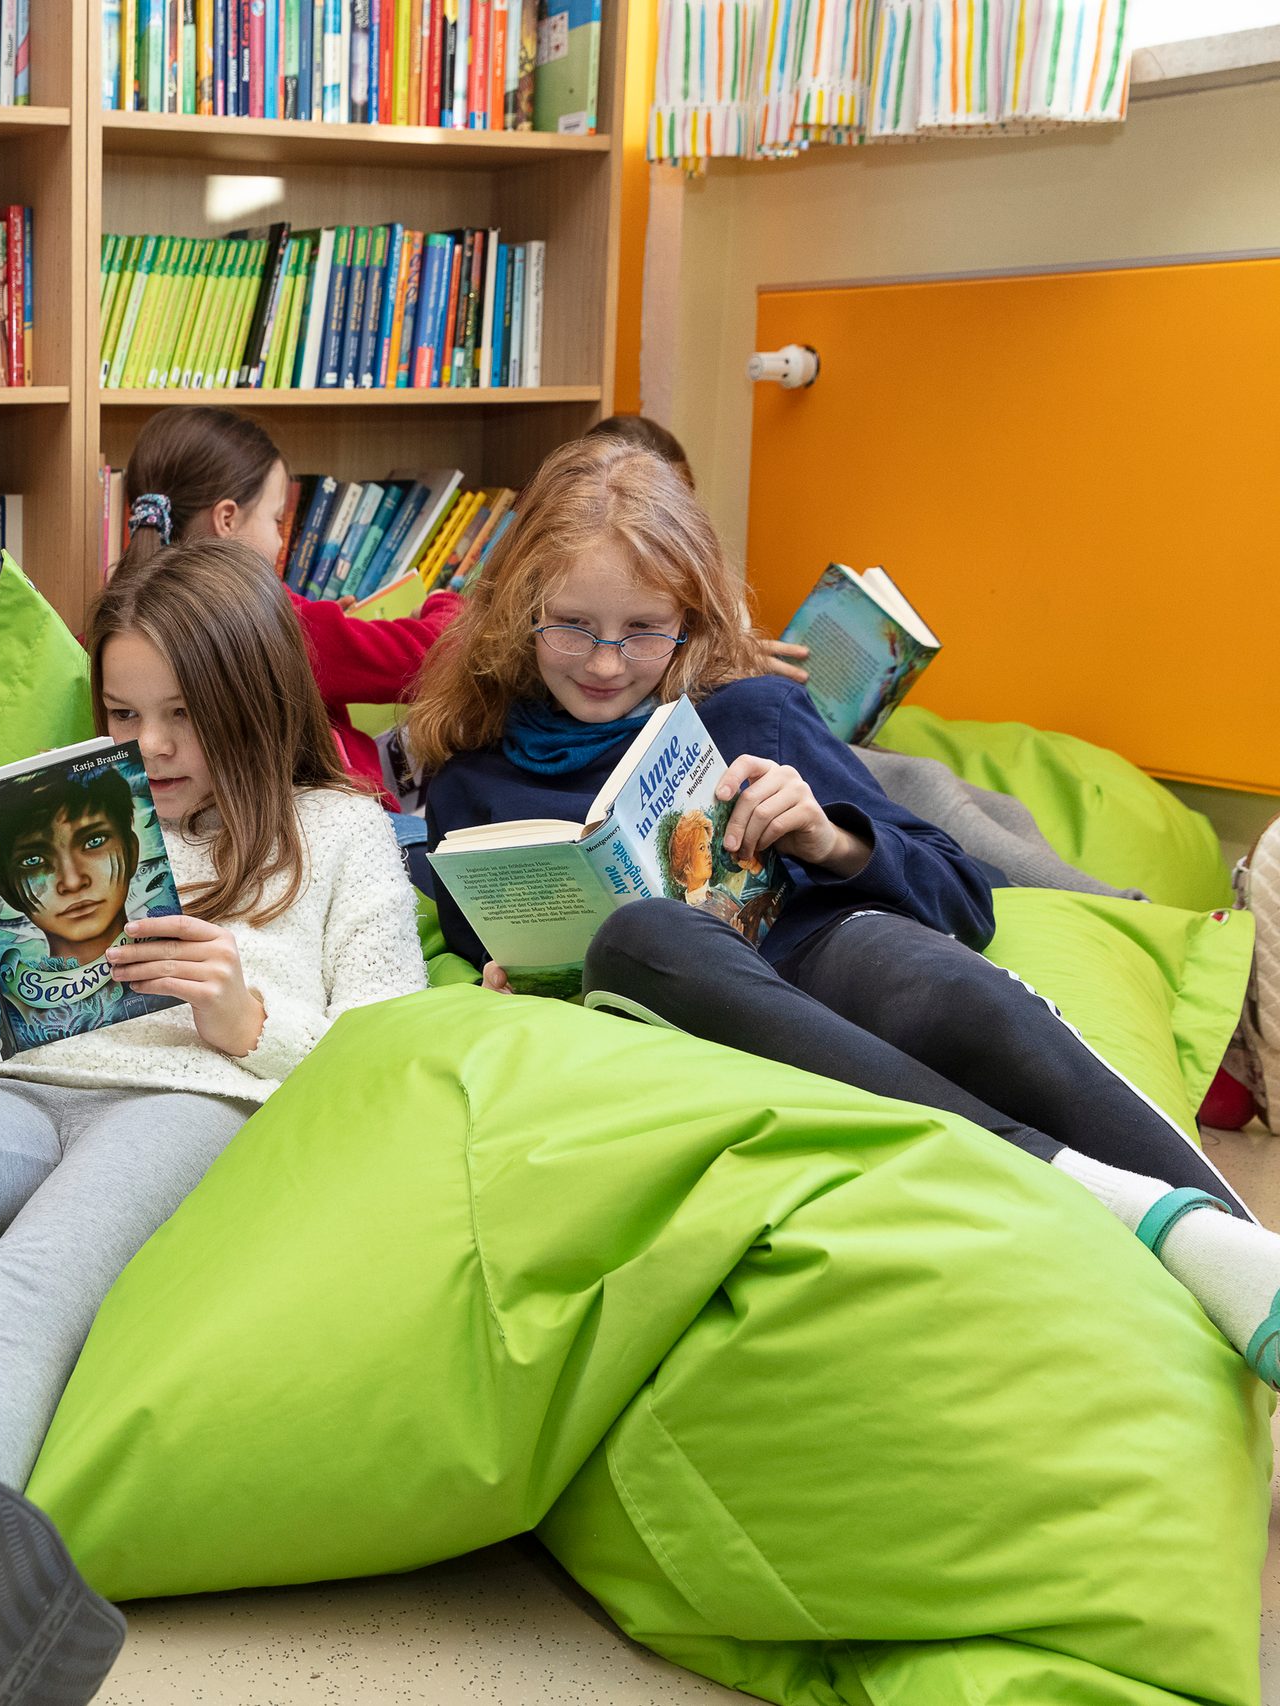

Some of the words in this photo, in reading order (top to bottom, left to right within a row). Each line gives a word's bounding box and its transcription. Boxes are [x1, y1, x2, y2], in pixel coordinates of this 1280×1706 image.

[72, 758, 96, 774] Katja
[96, 750, 129, 768] Brandis
[638, 735, 681, 811] Anne
[685, 756, 716, 799] Montgomery
[688, 761, 704, 782] Lucy
[698, 744, 714, 767] Maud
[636, 816, 654, 841] in
[648, 741, 702, 823] Ingleside
[586, 823, 621, 854] Montgomery
[604, 865, 631, 895] Anne
[612, 840, 645, 892] Ingleside
